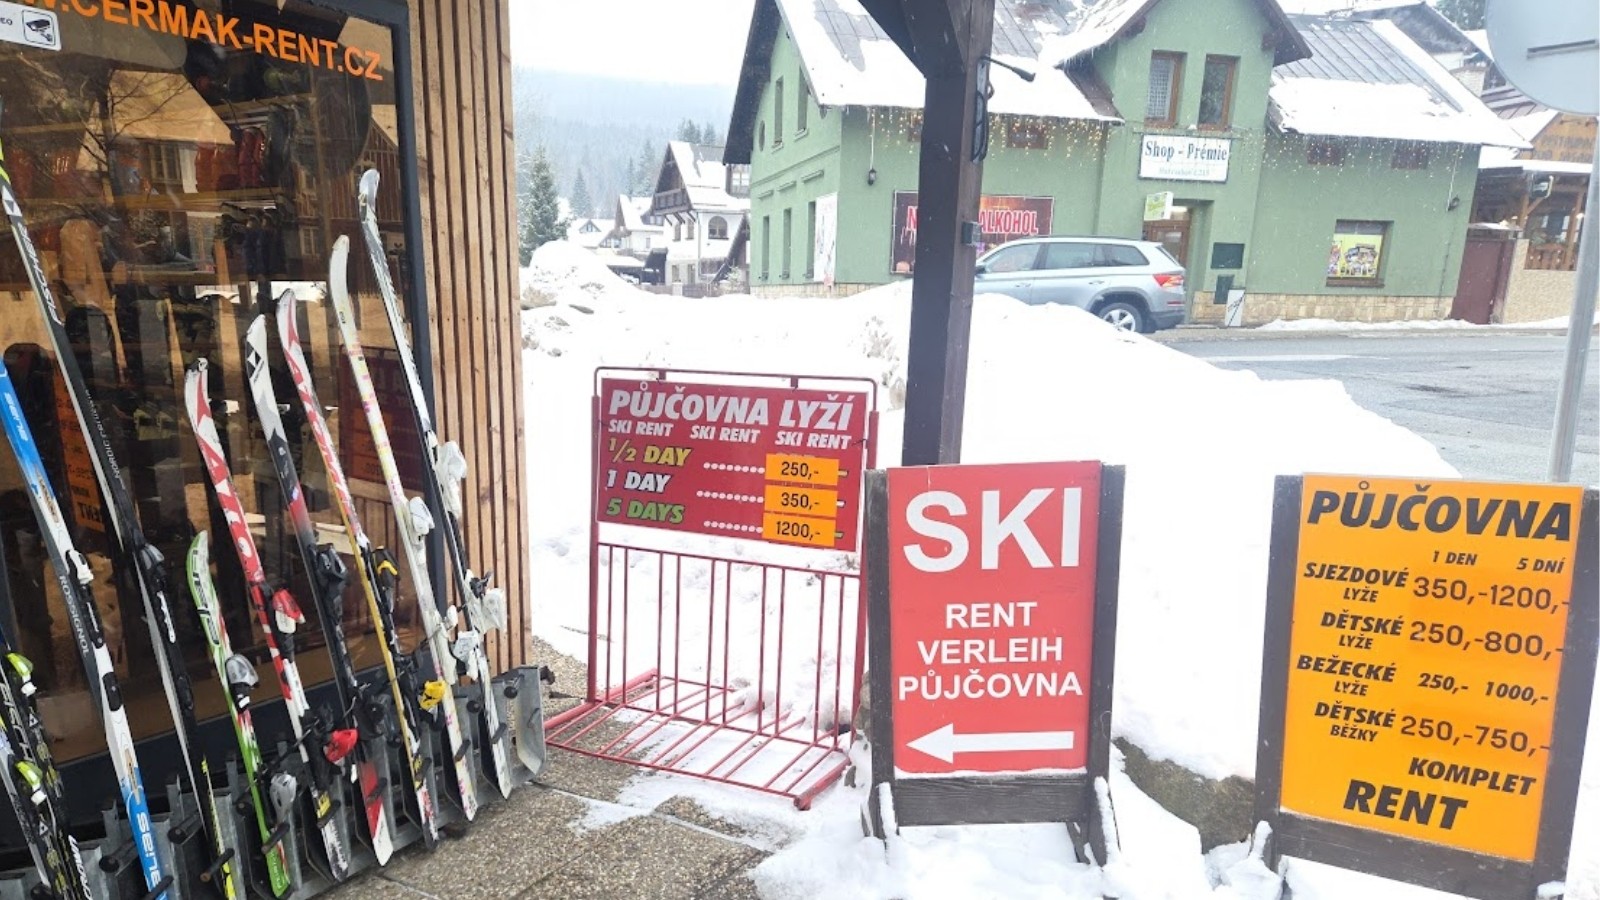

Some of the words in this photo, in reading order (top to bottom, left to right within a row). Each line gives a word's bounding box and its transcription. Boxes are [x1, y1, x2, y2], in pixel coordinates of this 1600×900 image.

[1145, 140, 1175, 162] Shop
[1187, 143, 1228, 160] Prémie
[979, 210, 1038, 235] ALKOHOL
[608, 381, 769, 426] PŮJČOVNA
[778, 394, 856, 431] LYŽÍ
[608, 419, 633, 434] SKI
[635, 421, 674, 437] RENT
[690, 425, 716, 440] SKI
[719, 427, 761, 444] RENT
[775, 431, 802, 447] SKI
[805, 433, 852, 450] RENT
[608, 437, 636, 463] 1/2
[642, 445, 692, 467] DAY
[781, 461, 820, 480] 250,-
[606, 469, 617, 488] 1
[624, 471, 671, 493] DAY
[781, 492, 820, 511] 350,-
[606, 498, 622, 516] 5
[627, 500, 685, 524] DAYS
[776, 521, 821, 541] 1200,-
[903, 487, 1082, 572] SKI
[1307, 480, 1572, 542] PŮJČOVNA
[1432, 551, 1440, 564] 1
[1445, 552, 1478, 566] DEN
[1516, 558, 1528, 570] 5
[1533, 556, 1566, 574] DNÍ
[1303, 562, 1410, 588] SJEZDOVÉ
[1413, 577, 1488, 605] 350,-
[1488, 584, 1570, 614] 1200,-
[1343, 586, 1379, 602] LYŽE
[58, 574, 89, 657] ROSSIGNOL
[945, 602, 1038, 629] RENT
[917, 637, 1063, 665] VERLEIH
[1321, 611, 1404, 636] DĚTSKÉ
[1410, 620, 1485, 651] 250,-
[1484, 631, 1565, 661] 800,-
[1338, 634, 1374, 650] LYŽE
[899, 669, 1083, 700] PŮJČOVNA
[1297, 654, 1397, 682] BEŽECKÉ
[1418, 673, 1469, 693] 250,-
[1485, 681, 1549, 706] 1000,-
[1334, 680, 1369, 696] LYŽE
[1314, 702, 1396, 728] DĚTSKÉ
[1401, 716, 1473, 746] 250,-
[1473, 726, 1552, 757] 750,-
[1330, 724, 1378, 742] BĚŽKY
[1408, 757, 1537, 796] KOMPLET
[1342, 779, 1468, 830] RENT
